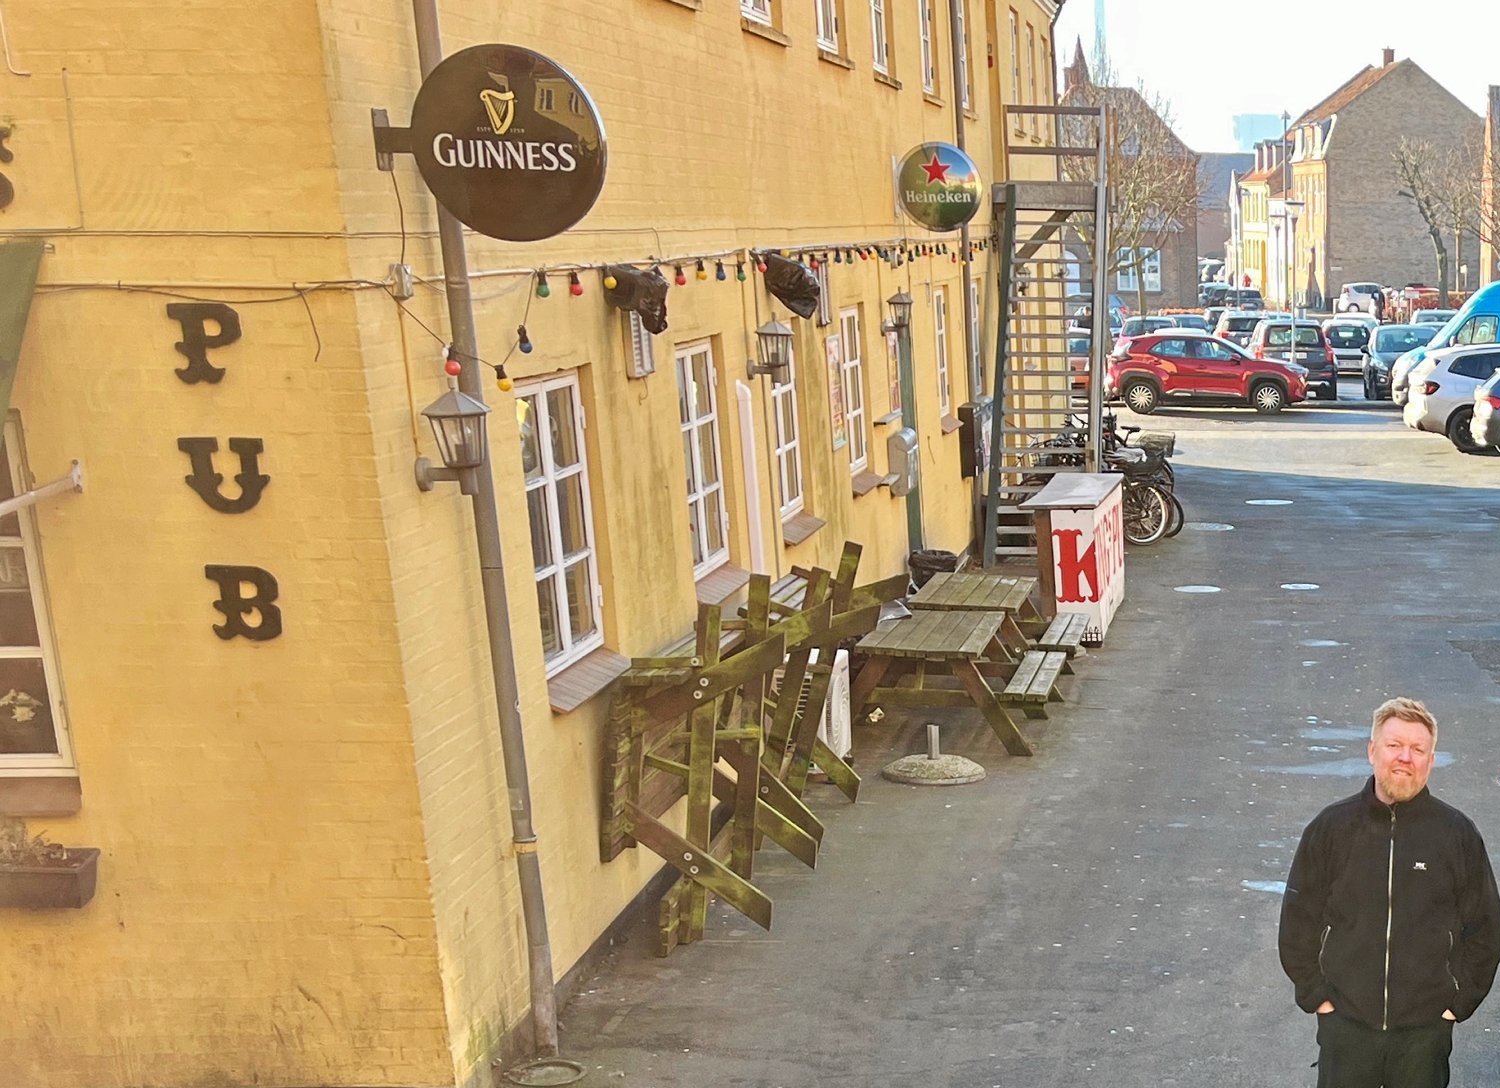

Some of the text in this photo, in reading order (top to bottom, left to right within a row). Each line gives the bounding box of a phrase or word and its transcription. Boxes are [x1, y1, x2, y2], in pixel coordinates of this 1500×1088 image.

[433, 133, 576, 172] GUINNESS
[905, 190, 971, 203] Heineken
[166, 303, 282, 641] PUB
